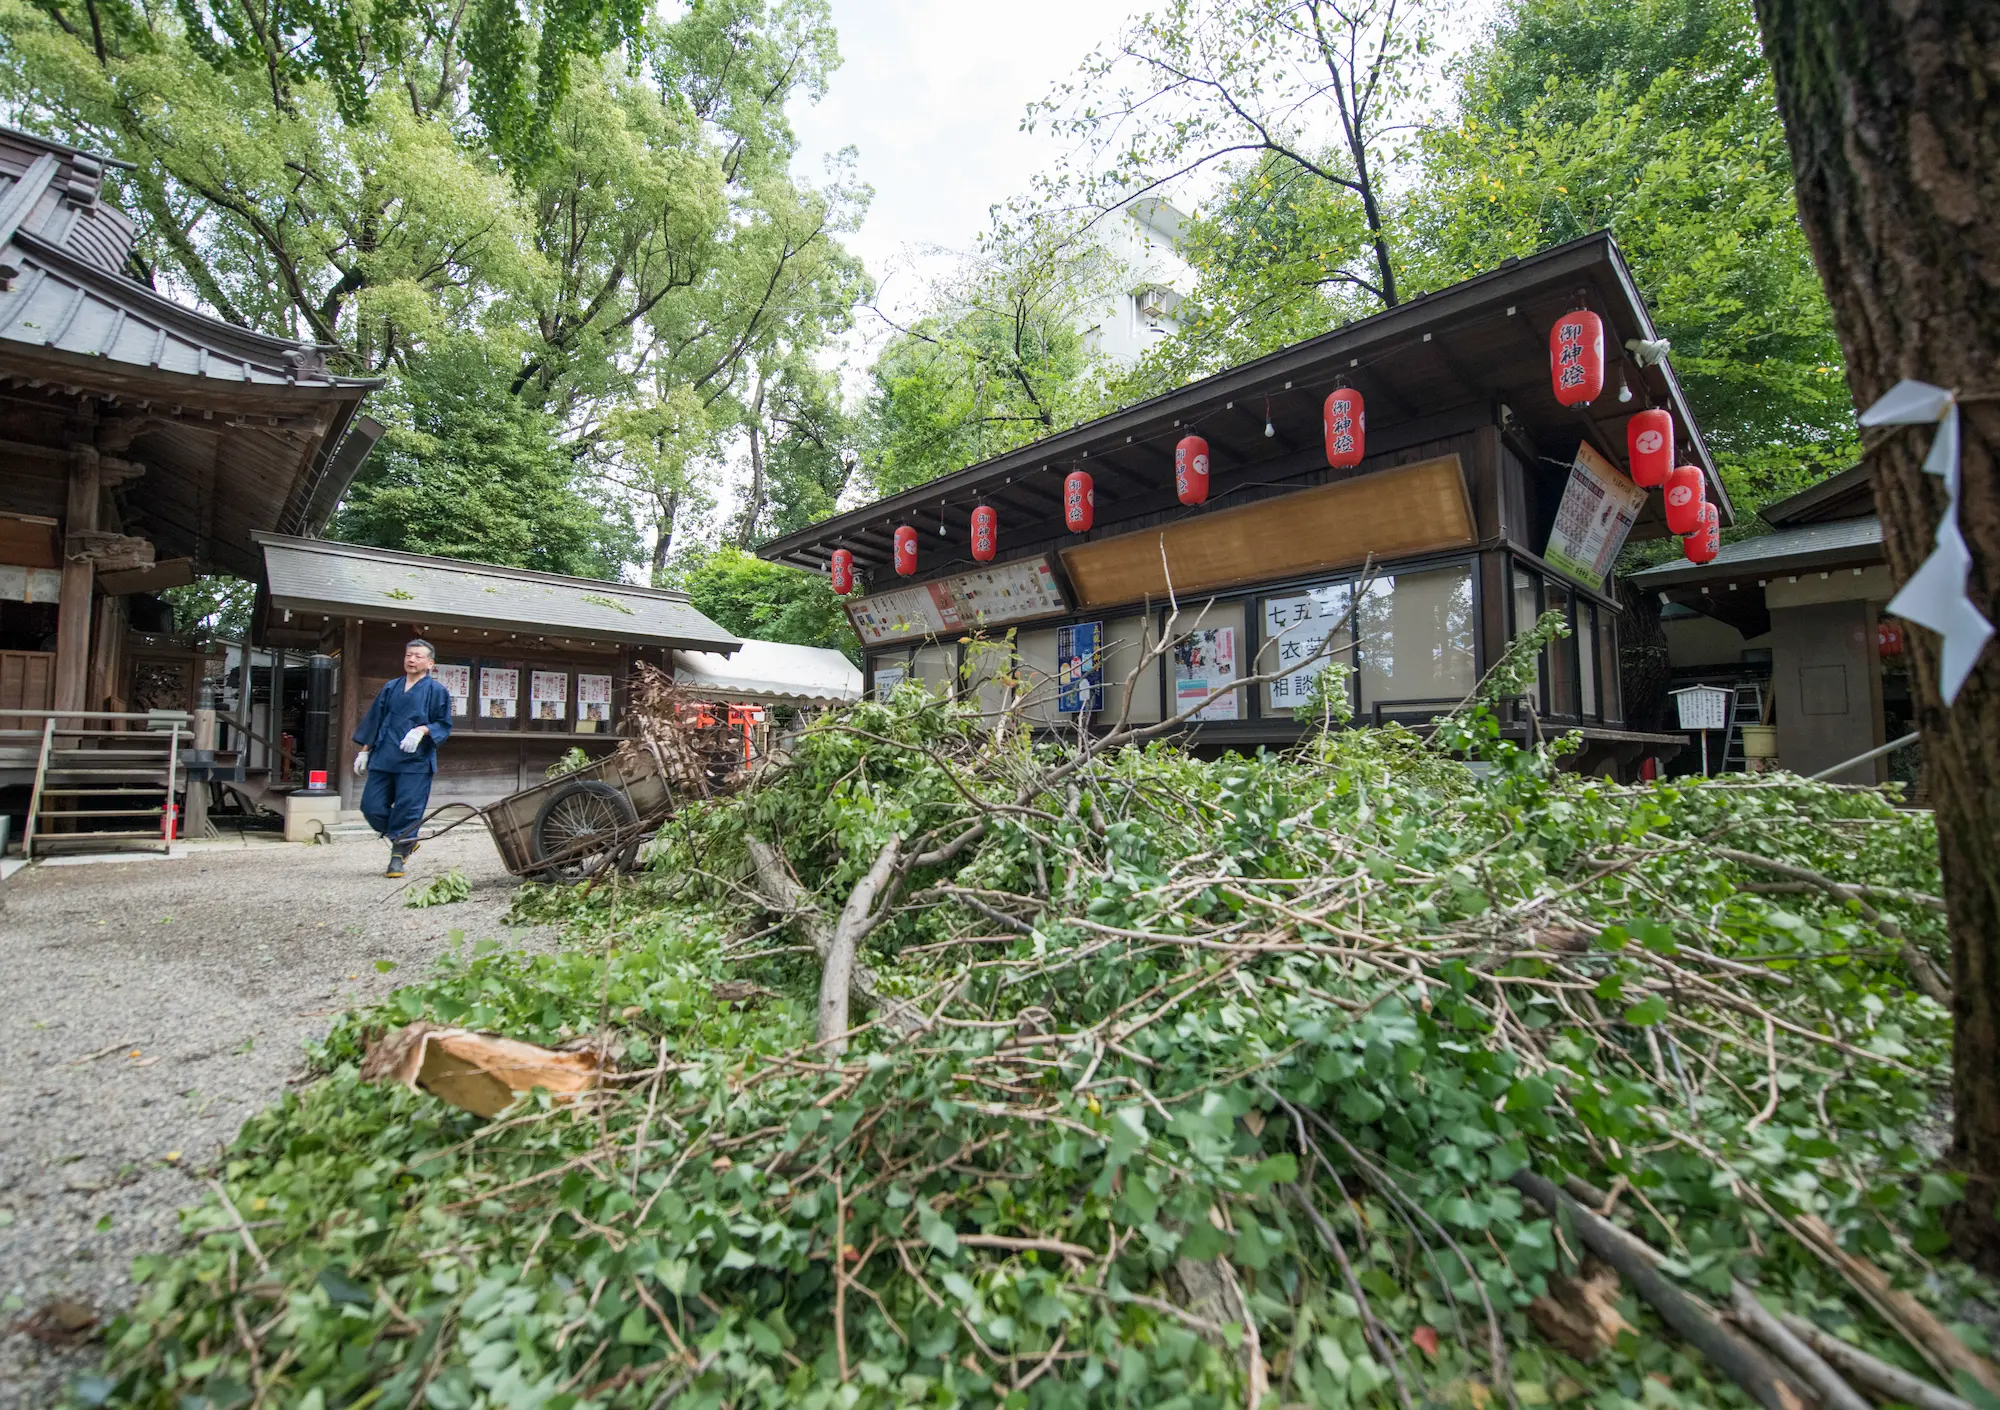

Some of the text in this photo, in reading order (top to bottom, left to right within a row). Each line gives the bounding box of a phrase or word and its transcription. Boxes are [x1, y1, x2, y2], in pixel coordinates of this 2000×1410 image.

[1558, 322, 1586, 391] 御神燈
[1333, 400, 1354, 455] 御神燈
[1068, 479, 1083, 523] 御神燈
[977, 513, 991, 552] 御神燈
[1273, 675, 1314, 697] 相談
